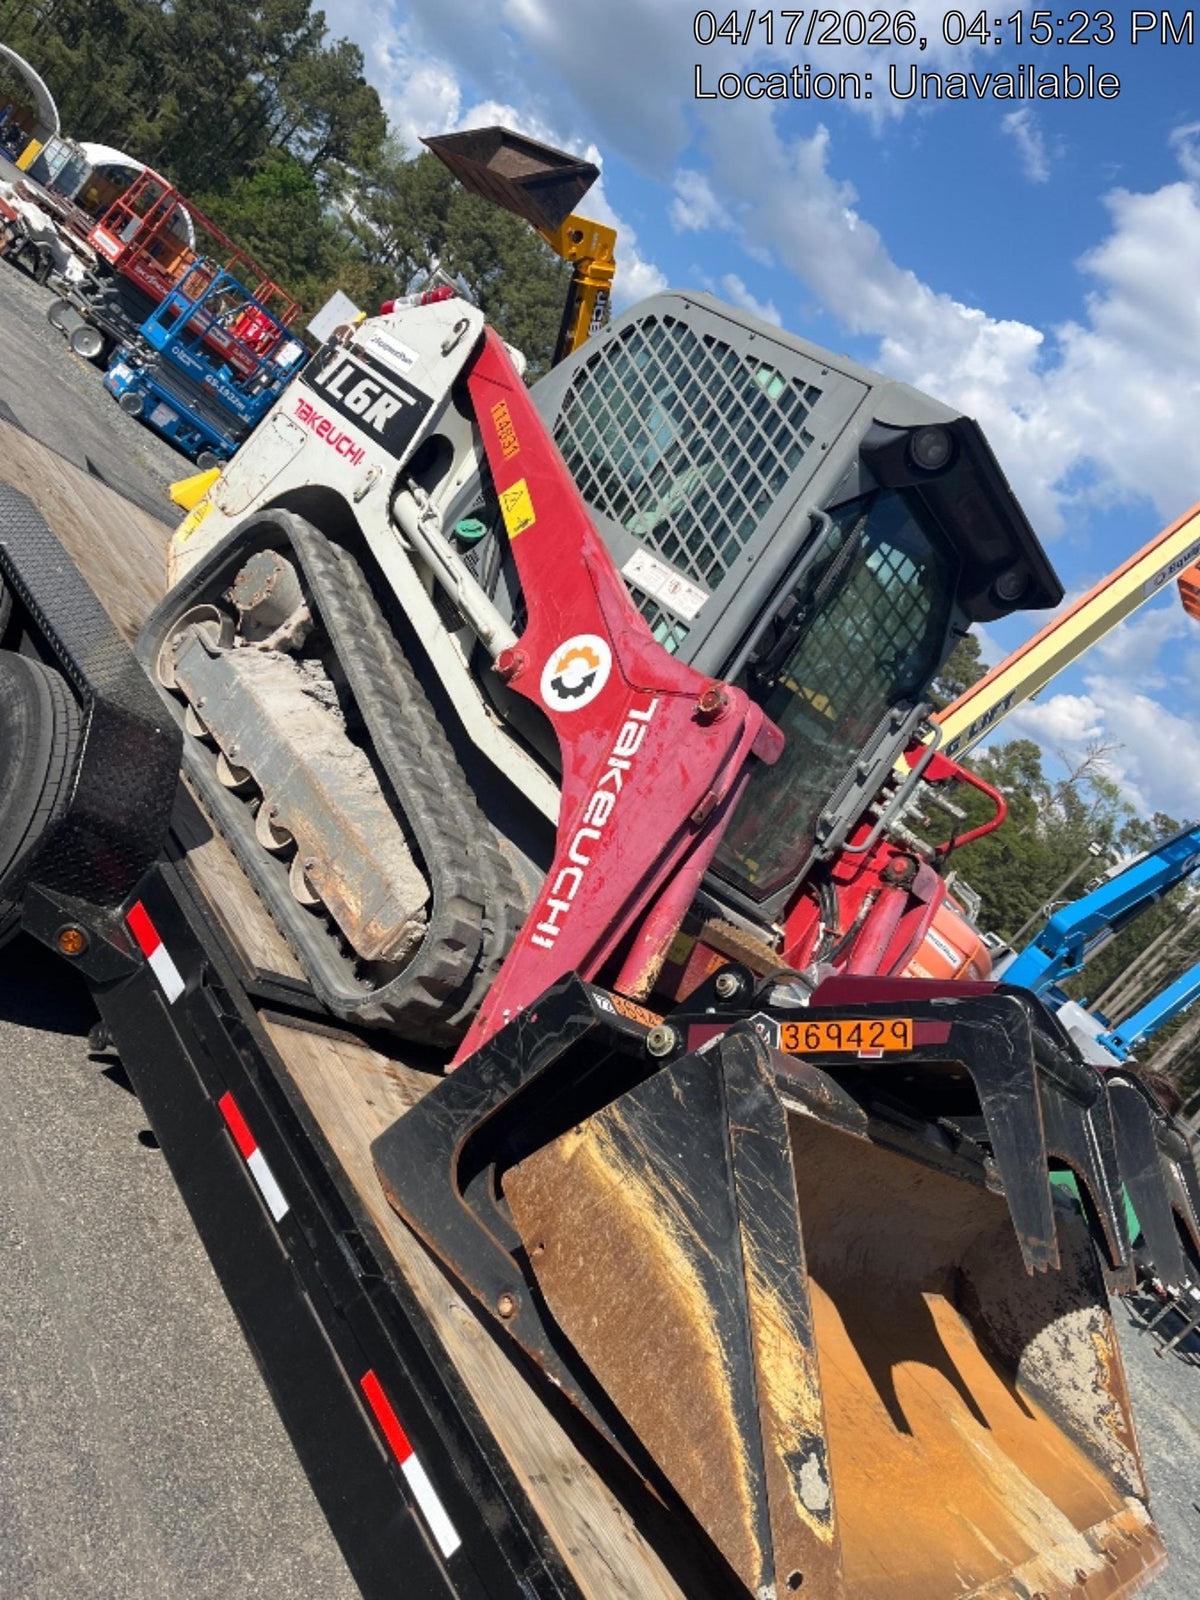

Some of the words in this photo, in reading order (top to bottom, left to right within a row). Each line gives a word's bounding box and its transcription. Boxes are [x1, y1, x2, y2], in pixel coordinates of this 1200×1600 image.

[314, 344, 417, 434] TL6R
[294, 397, 367, 467] TAKEUCHI
[530, 698, 660, 949] TAKEUCHI
[785, 1021, 908, 1051] 369429
